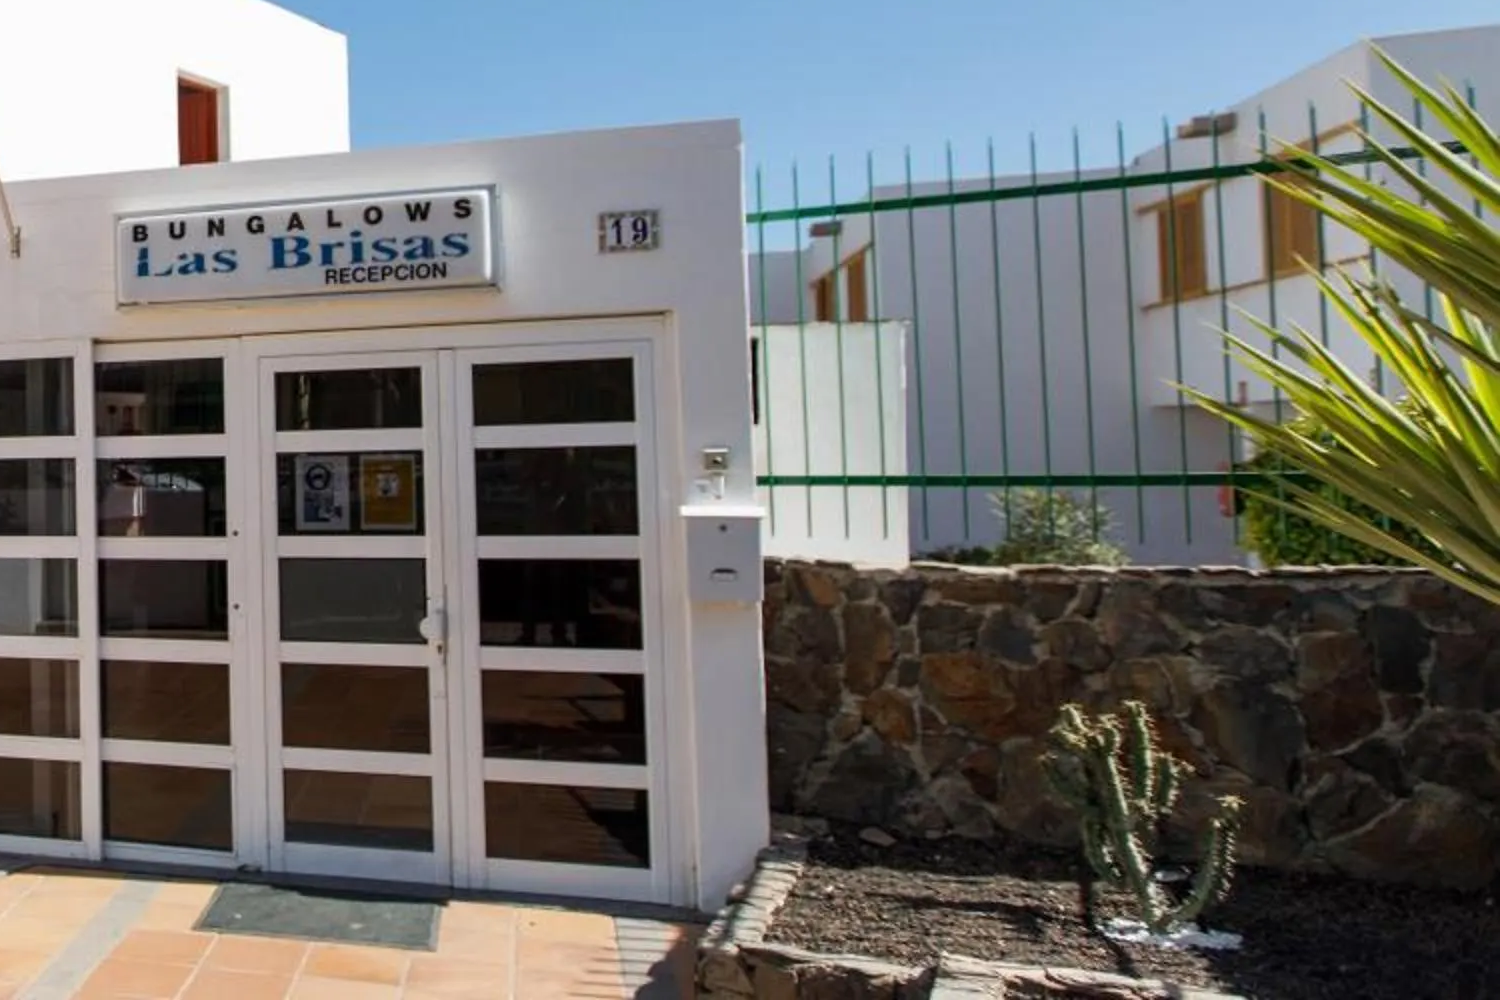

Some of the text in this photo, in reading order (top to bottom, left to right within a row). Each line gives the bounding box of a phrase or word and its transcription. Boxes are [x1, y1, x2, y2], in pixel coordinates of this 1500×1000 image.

[133, 199, 473, 243] BUNGALOWS
[611, 216, 648, 245] 19
[136, 230, 471, 278] Las Brisas
[325, 262, 448, 285] RECEPCION
